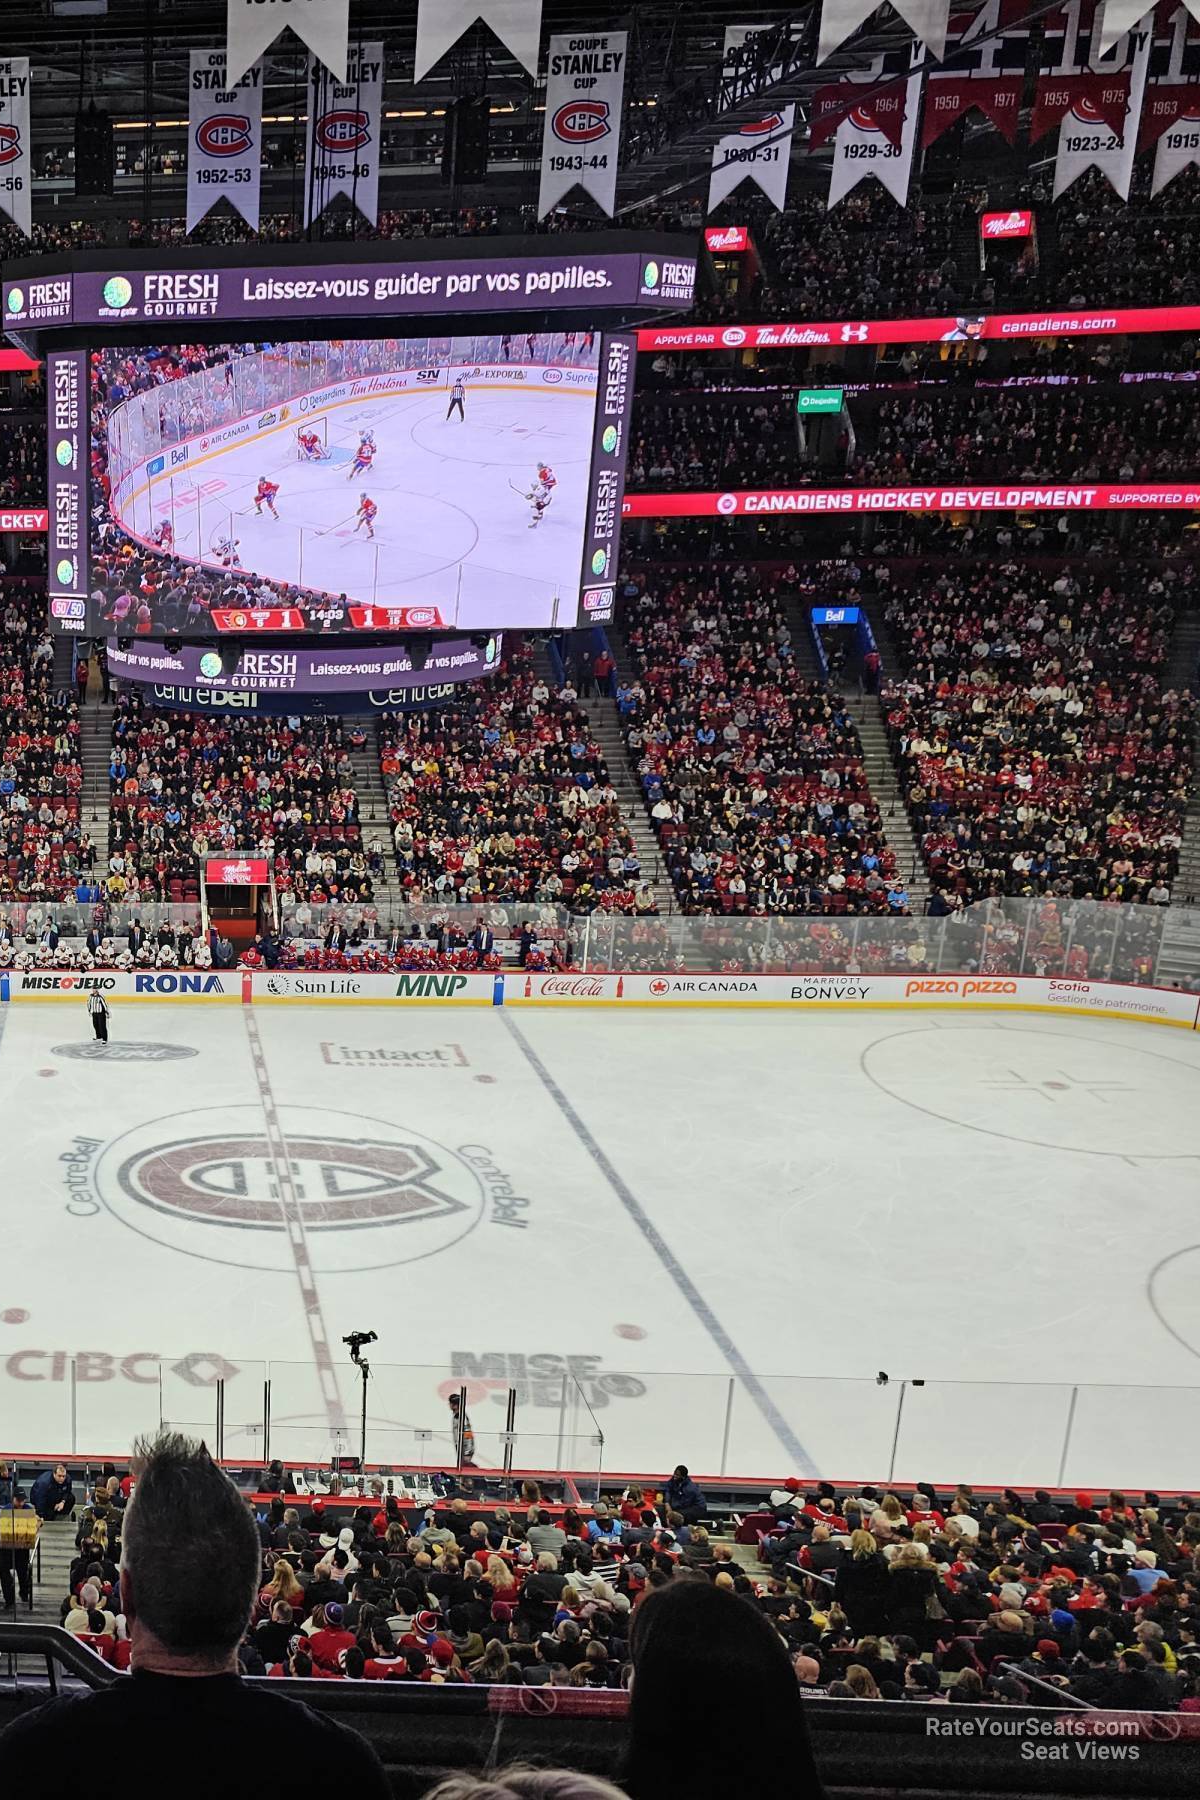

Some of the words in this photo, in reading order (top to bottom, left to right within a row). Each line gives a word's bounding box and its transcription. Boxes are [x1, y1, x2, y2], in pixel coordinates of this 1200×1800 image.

[569, 38, 608, 51] COUPE
[551, 52, 623, 75] STANLEY
[574, 77, 598, 90] CUP
[214, 92, 238, 104] CUP
[333, 87, 356, 99] CUP
[994, 92, 1016, 107] 1971
[1043, 91, 1070, 106] 1955
[1101, 89, 1125, 104] 1975
[875, 98, 899, 112] 1964
[934, 95, 960, 110] 1950
[1151, 100, 1178, 115] 1963
[843, 143, 903, 159] 1929-30
[1065, 136, 1125, 152] 1923-24
[549, 155, 608, 171] 1943-44
[195, 168, 251, 184] 1952-53
[313, 164, 370, 180] 1945-46
[985, 217, 1027, 236] Molson
[707, 236, 743, 251] Molson
[661, 262, 695, 284] FRESH
[145, 274, 219, 299] FRESH
[243, 276, 369, 301] Laissez-vous
[373, 272, 443, 301] guider
[446, 271, 481, 294] par
[485, 272, 521, 292] vos
[525, 266, 612, 293] papilles.
[30, 281, 71, 305] FRESH
[660, 285, 693, 299] GOURMET
[29, 304, 70, 318] GOURMET
[144, 301, 218, 316] GOURMET
[1002, 318, 1116, 334] canadiens.com
[654, 334, 687, 345] APPUYÉ
[689, 333, 714, 345] PAR
[604, 342, 623, 415] FRESH
[617, 344, 630, 415] GOURMET
[55, 360, 69, 430] FRESH
[70, 360, 78, 429] GOURMET
[309, 387, 346, 406] Desjardins
[171, 445, 189, 465] Bell
[594, 470, 612, 539] FRESH
[606, 471, 619, 538] GOURMET
[744, 494, 851, 511] CANADIENS
[857, 492, 934, 509] HOCKEY
[941, 489, 1096, 508] DEVELOPMENT
[1109, 494, 1179, 505] SUPPORTED
[1184, 494, 1200, 504] BY
[56, 483, 70, 549] FRESH
[71, 484, 79, 549] GOURMET
[54, 601, 83, 616] 50/50
[309, 610, 343, 621] 14:03
[824, 609, 844, 622] Bell
[281, 611, 291, 627] 1
[364, 610, 374, 626] 1
[231, 677, 297, 688] GOURMET
[135, 974, 225, 994] RONA
[294, 979, 325, 994] Sun
[330, 979, 361, 994] Life
[396, 974, 468, 997] MNP
[672, 982, 697, 992] AIR
[698, 982, 758, 992] CANADA
[905, 980, 958, 998] pizza
[962, 980, 1017, 998] pizza
[1049, 980, 1090, 993] Scotia
[790, 986, 870, 1000] BONVOY
[1047, 993, 1087, 1005] Gestion
[1089, 996, 1104, 1006] de
[1104, 999, 1169, 1015] patrimoine.
[340, 1046, 450, 1061] intact
[5, 1349, 162, 1383] CIBC
[451, 1351, 604, 1382] MISE
